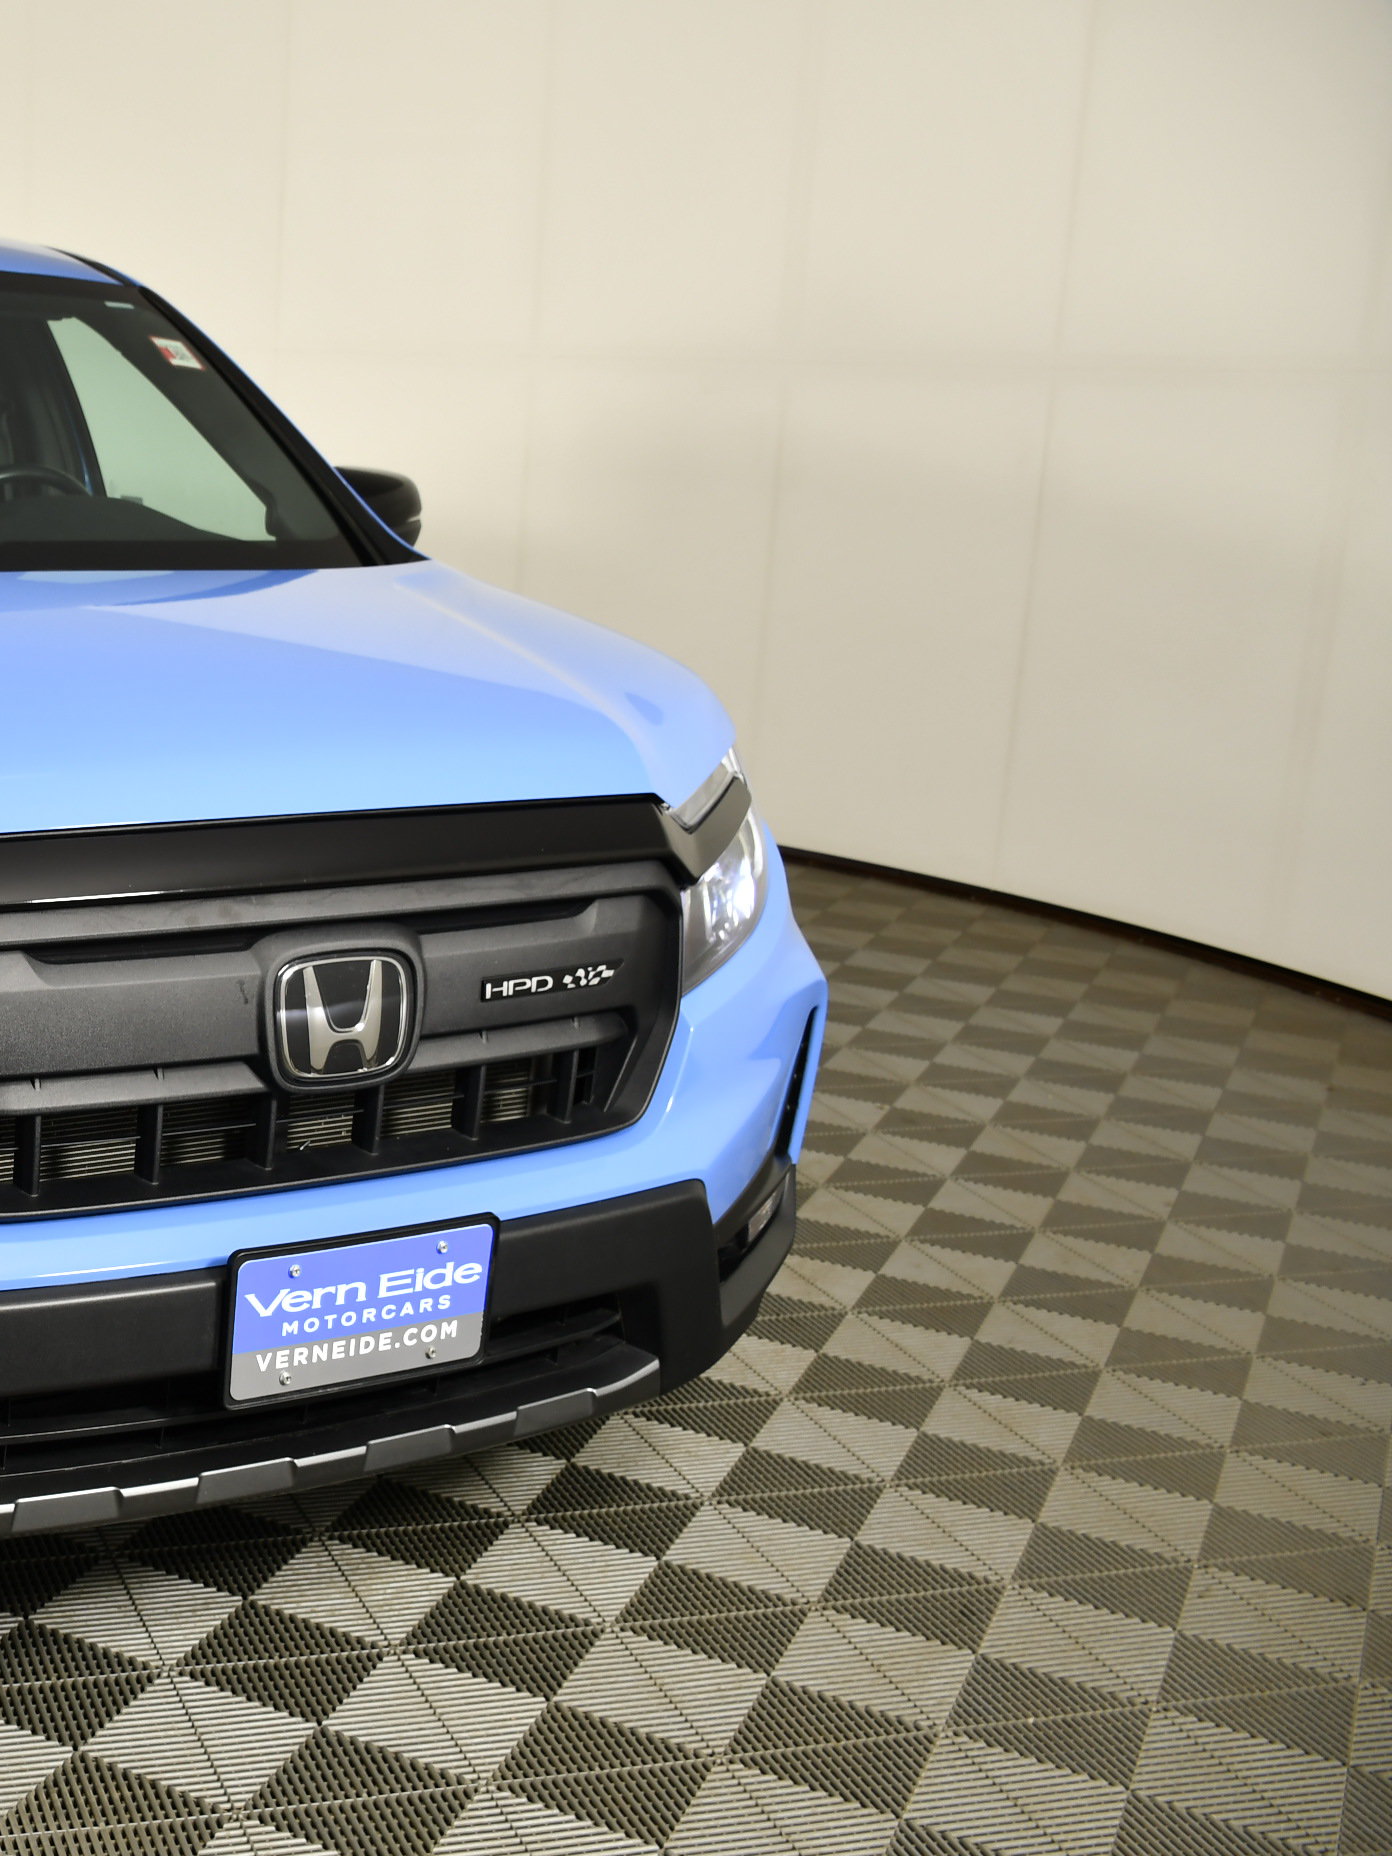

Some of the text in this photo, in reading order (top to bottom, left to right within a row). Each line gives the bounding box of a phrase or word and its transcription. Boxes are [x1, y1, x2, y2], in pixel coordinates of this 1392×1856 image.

[485, 975, 553, 999] HPD
[244, 1261, 483, 1317] Vern Eide
[281, 1294, 451, 1337] MOTORCARS
[255, 1319, 458, 1372] VERNEIDE.COM
